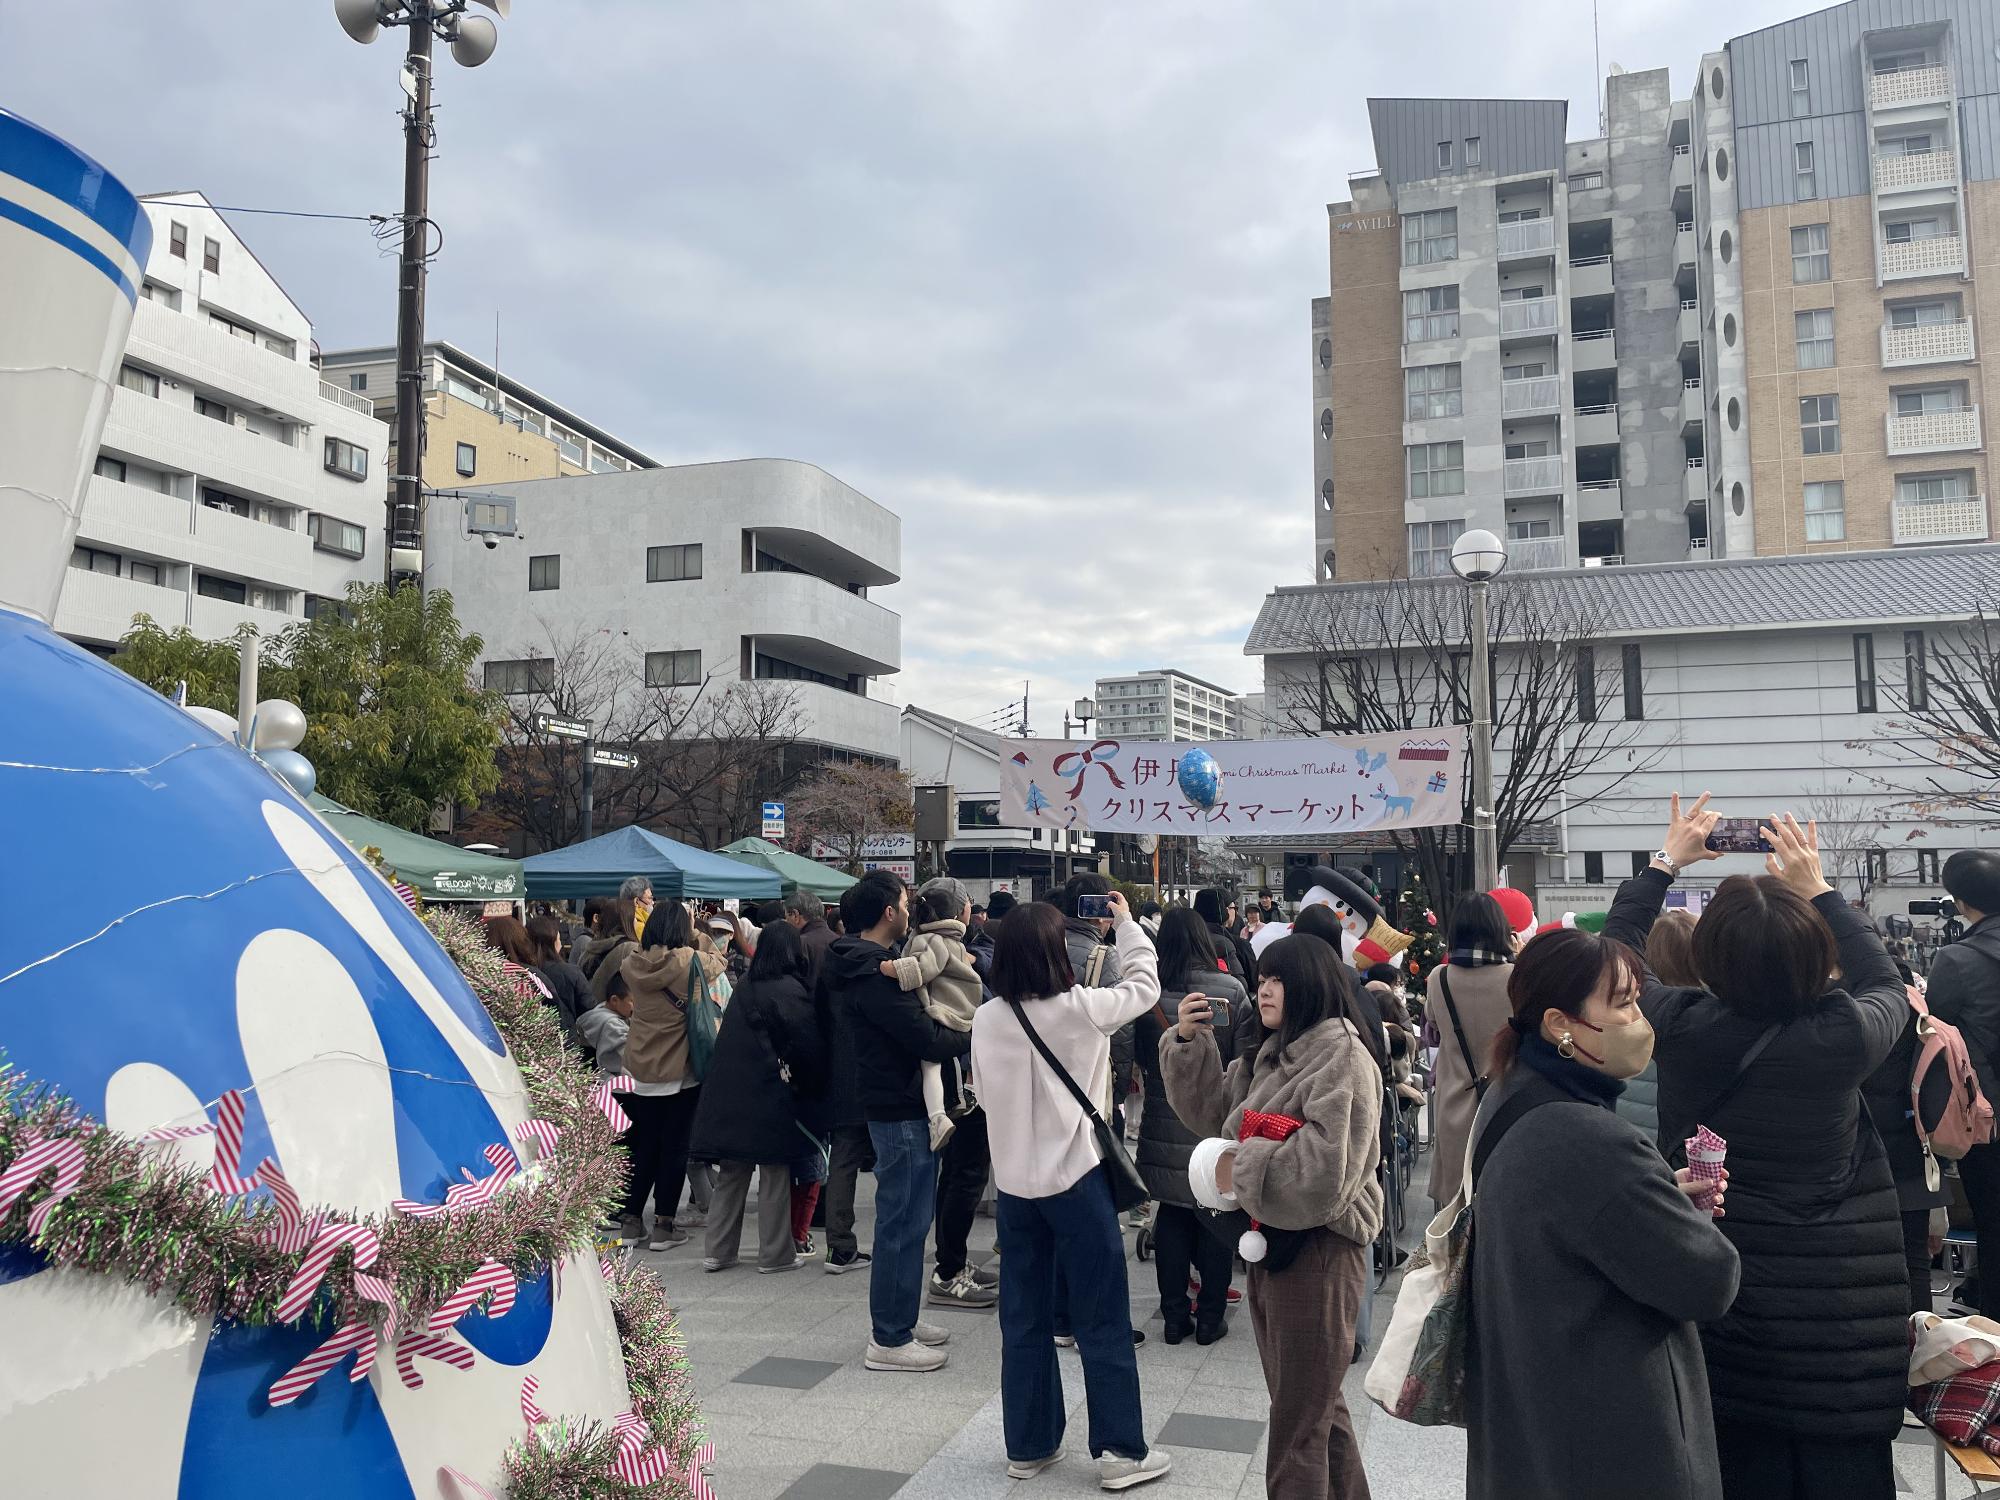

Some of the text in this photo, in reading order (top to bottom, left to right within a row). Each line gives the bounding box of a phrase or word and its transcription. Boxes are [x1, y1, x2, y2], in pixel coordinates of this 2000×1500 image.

[1356, 215, 1396, 230] WILL
[1238, 765, 1299, 778] Christmas
[1302, 761, 1347, 775] Market
[1102, 794, 1364, 824] クリスマスマーケット
